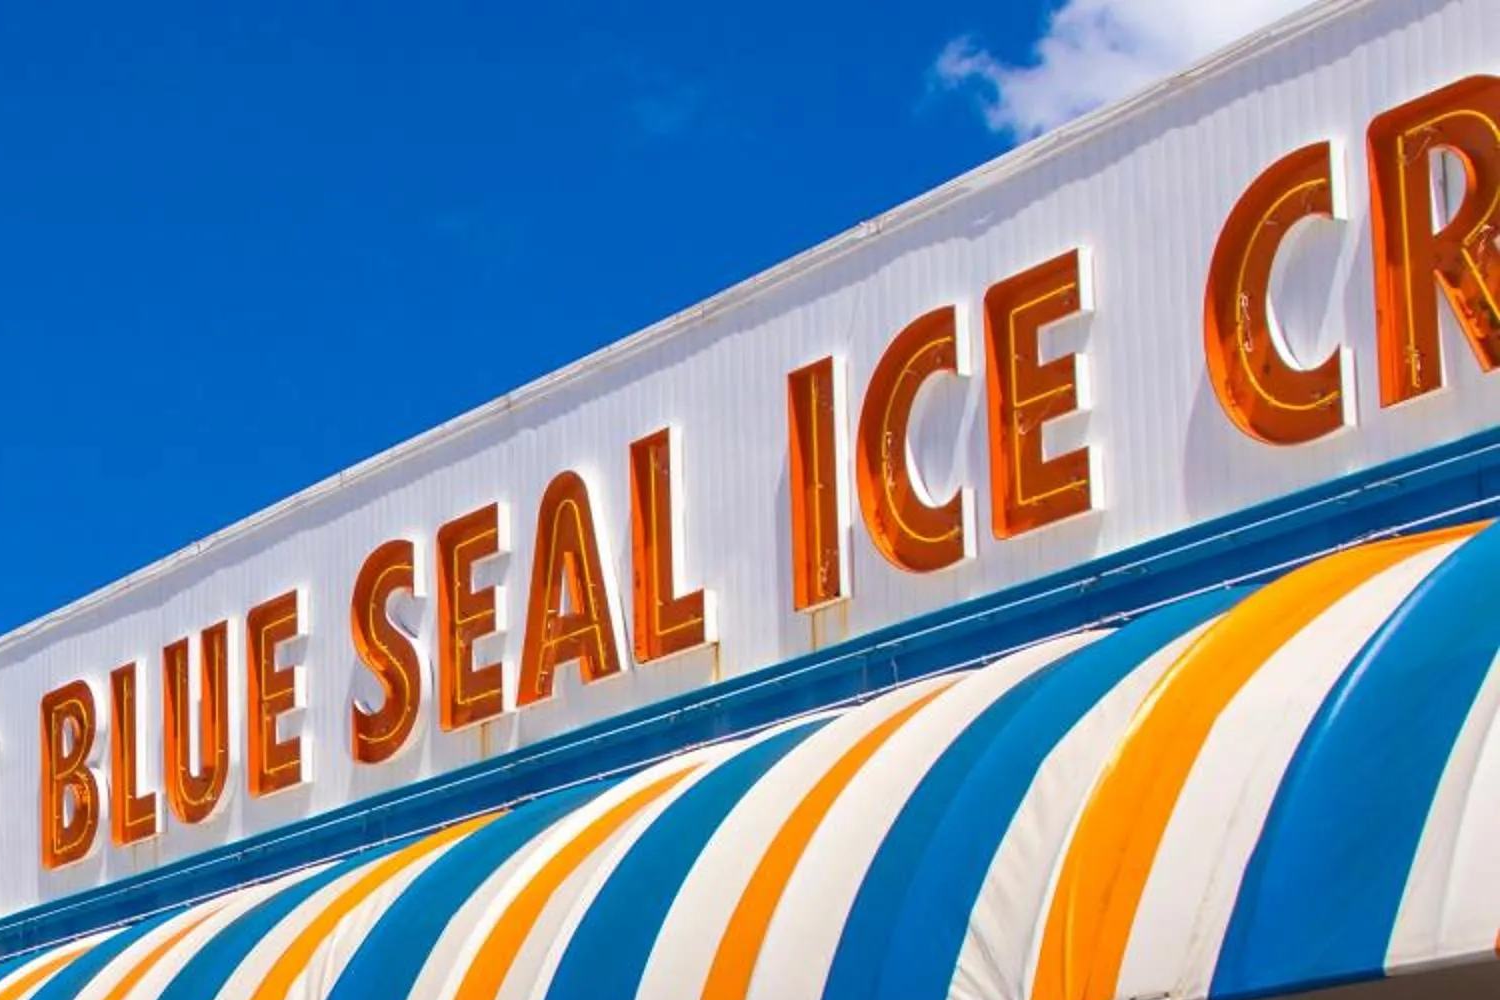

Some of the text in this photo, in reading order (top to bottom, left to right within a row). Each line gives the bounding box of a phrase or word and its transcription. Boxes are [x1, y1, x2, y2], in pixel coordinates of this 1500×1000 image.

[41, 588, 306, 870] BLUE
[350, 426, 710, 765] SEAL
[787, 246, 1100, 612] ICE
